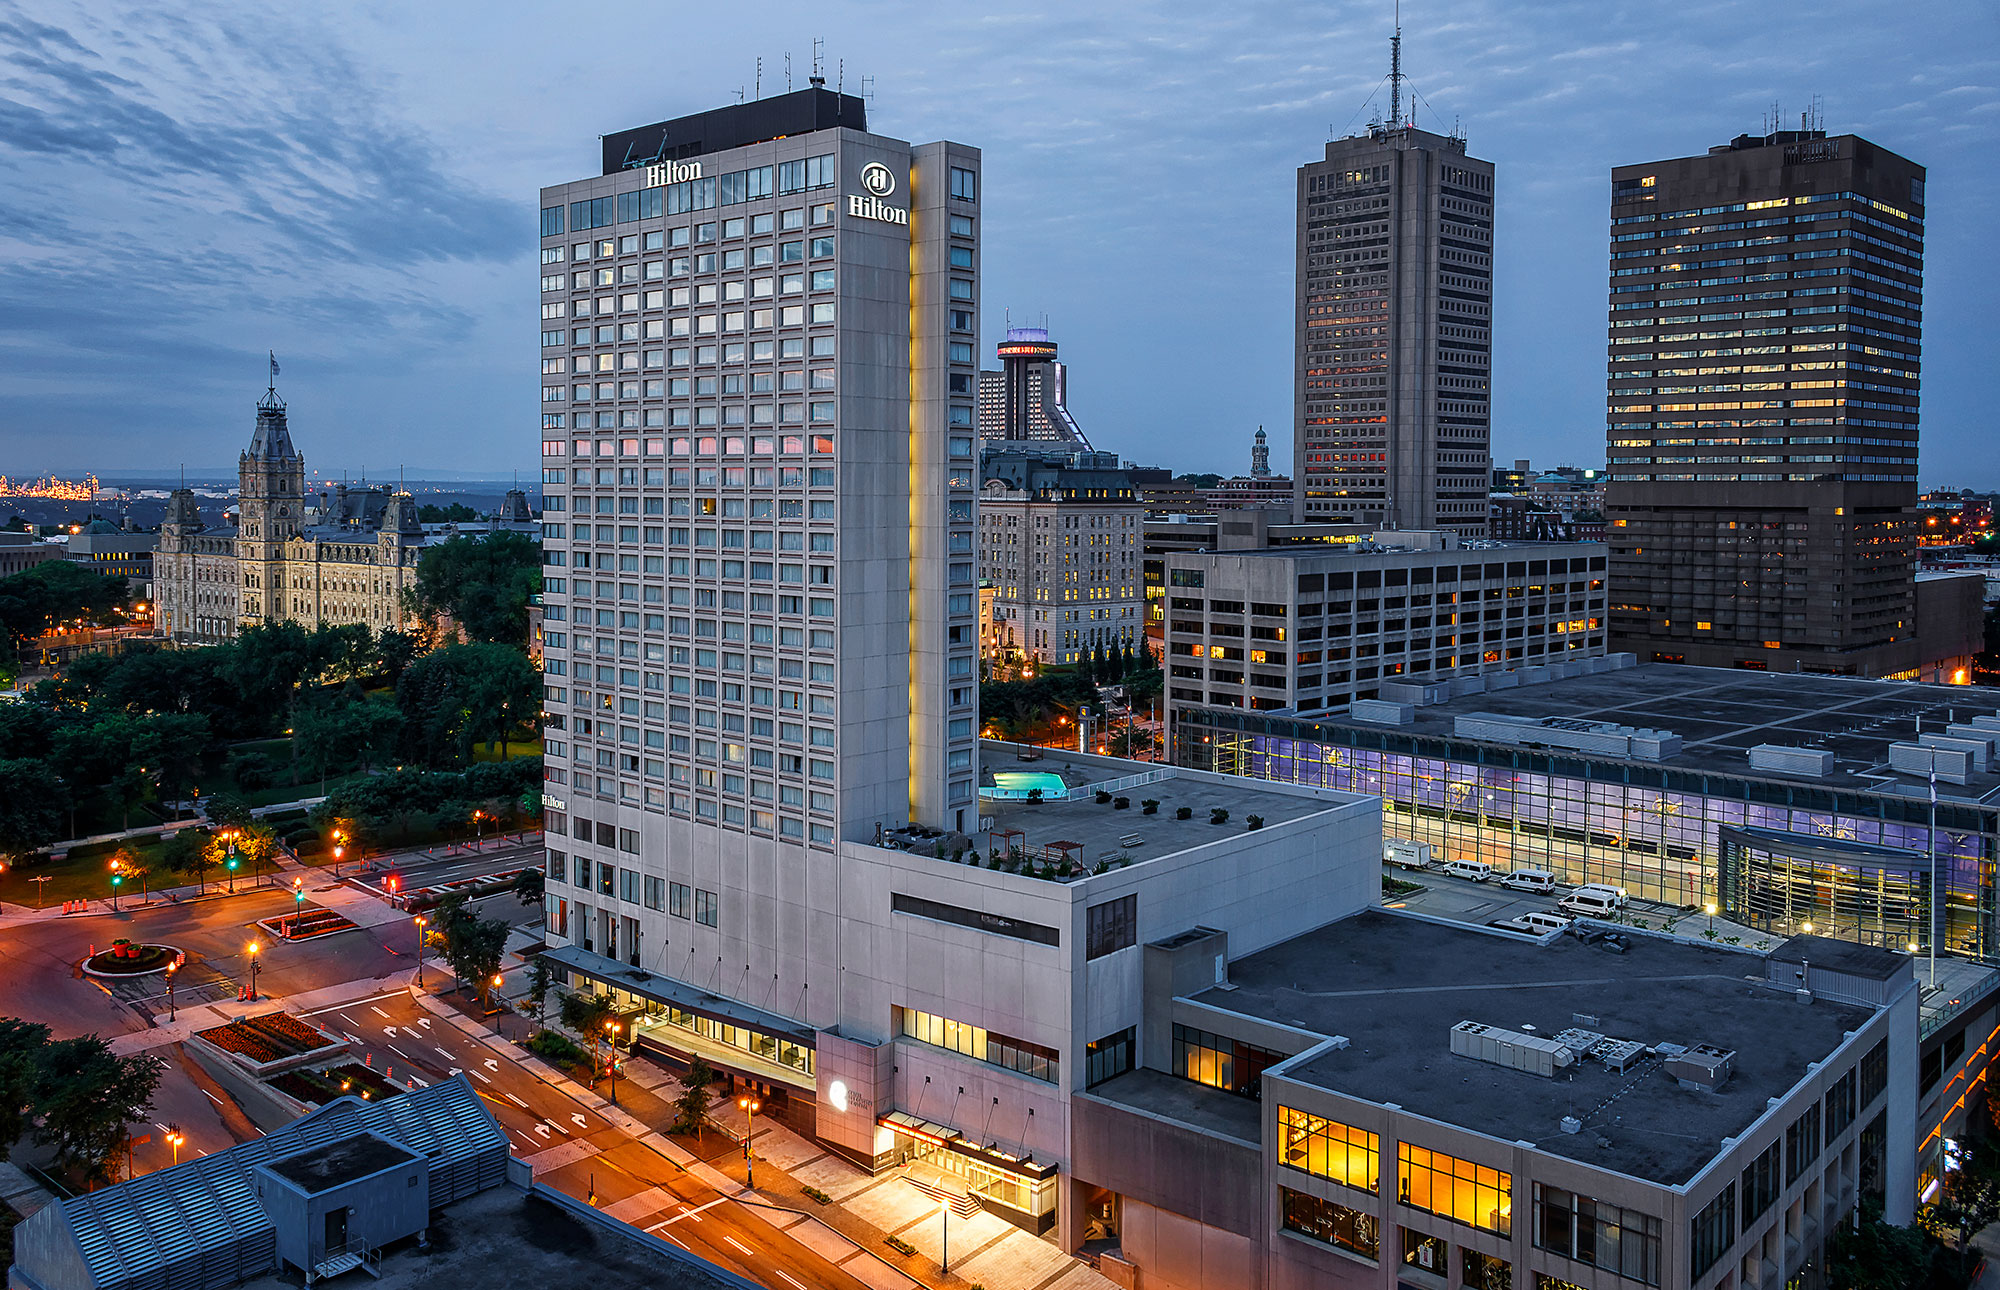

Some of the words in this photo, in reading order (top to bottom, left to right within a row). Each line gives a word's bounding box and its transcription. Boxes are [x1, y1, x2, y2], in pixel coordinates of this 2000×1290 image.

[646, 160, 703, 188] Hilton
[847, 195, 907, 224] Hilton
[541, 794, 566, 809] Hilton
